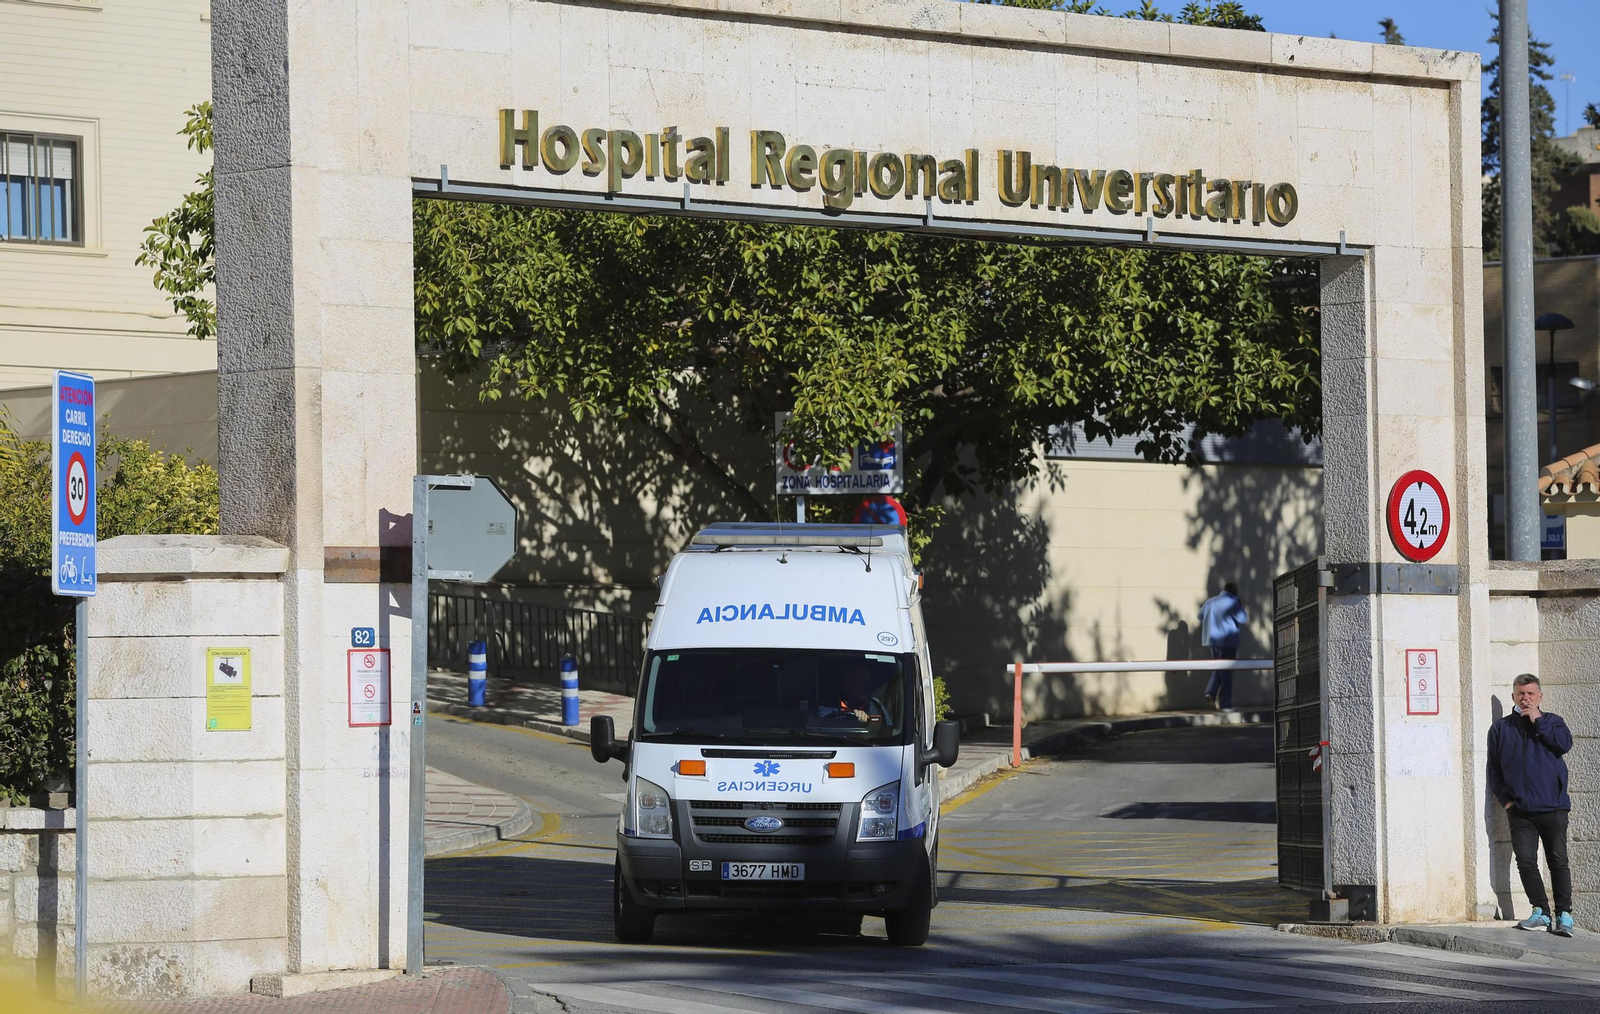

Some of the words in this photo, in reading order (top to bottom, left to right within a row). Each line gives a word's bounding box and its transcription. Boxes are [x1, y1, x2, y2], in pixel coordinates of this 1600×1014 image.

[498, 108, 730, 193] Hospital
[750, 129, 979, 212] Regional
[996, 149, 1299, 228] Universitario
[60, 385, 93, 406] ATENCIÓN
[65, 408, 87, 427] CARRIL
[62, 428, 91, 447] DERECHO
[70, 475, 84, 501] 30
[782, 475, 811, 490] ZONA
[815, 474, 891, 489] HOSPITALARIA
[59, 530, 94, 548] PREFERENCIA
[1547, 534, 1561, 542] SOLO
[354, 630, 370, 644] 82
[880, 635, 895, 643] 297
[750, 816, 778, 830] Ford
[691, 860, 711, 870] SP
[731, 864, 767, 879] 3677
[771, 864, 799, 879] HMD
